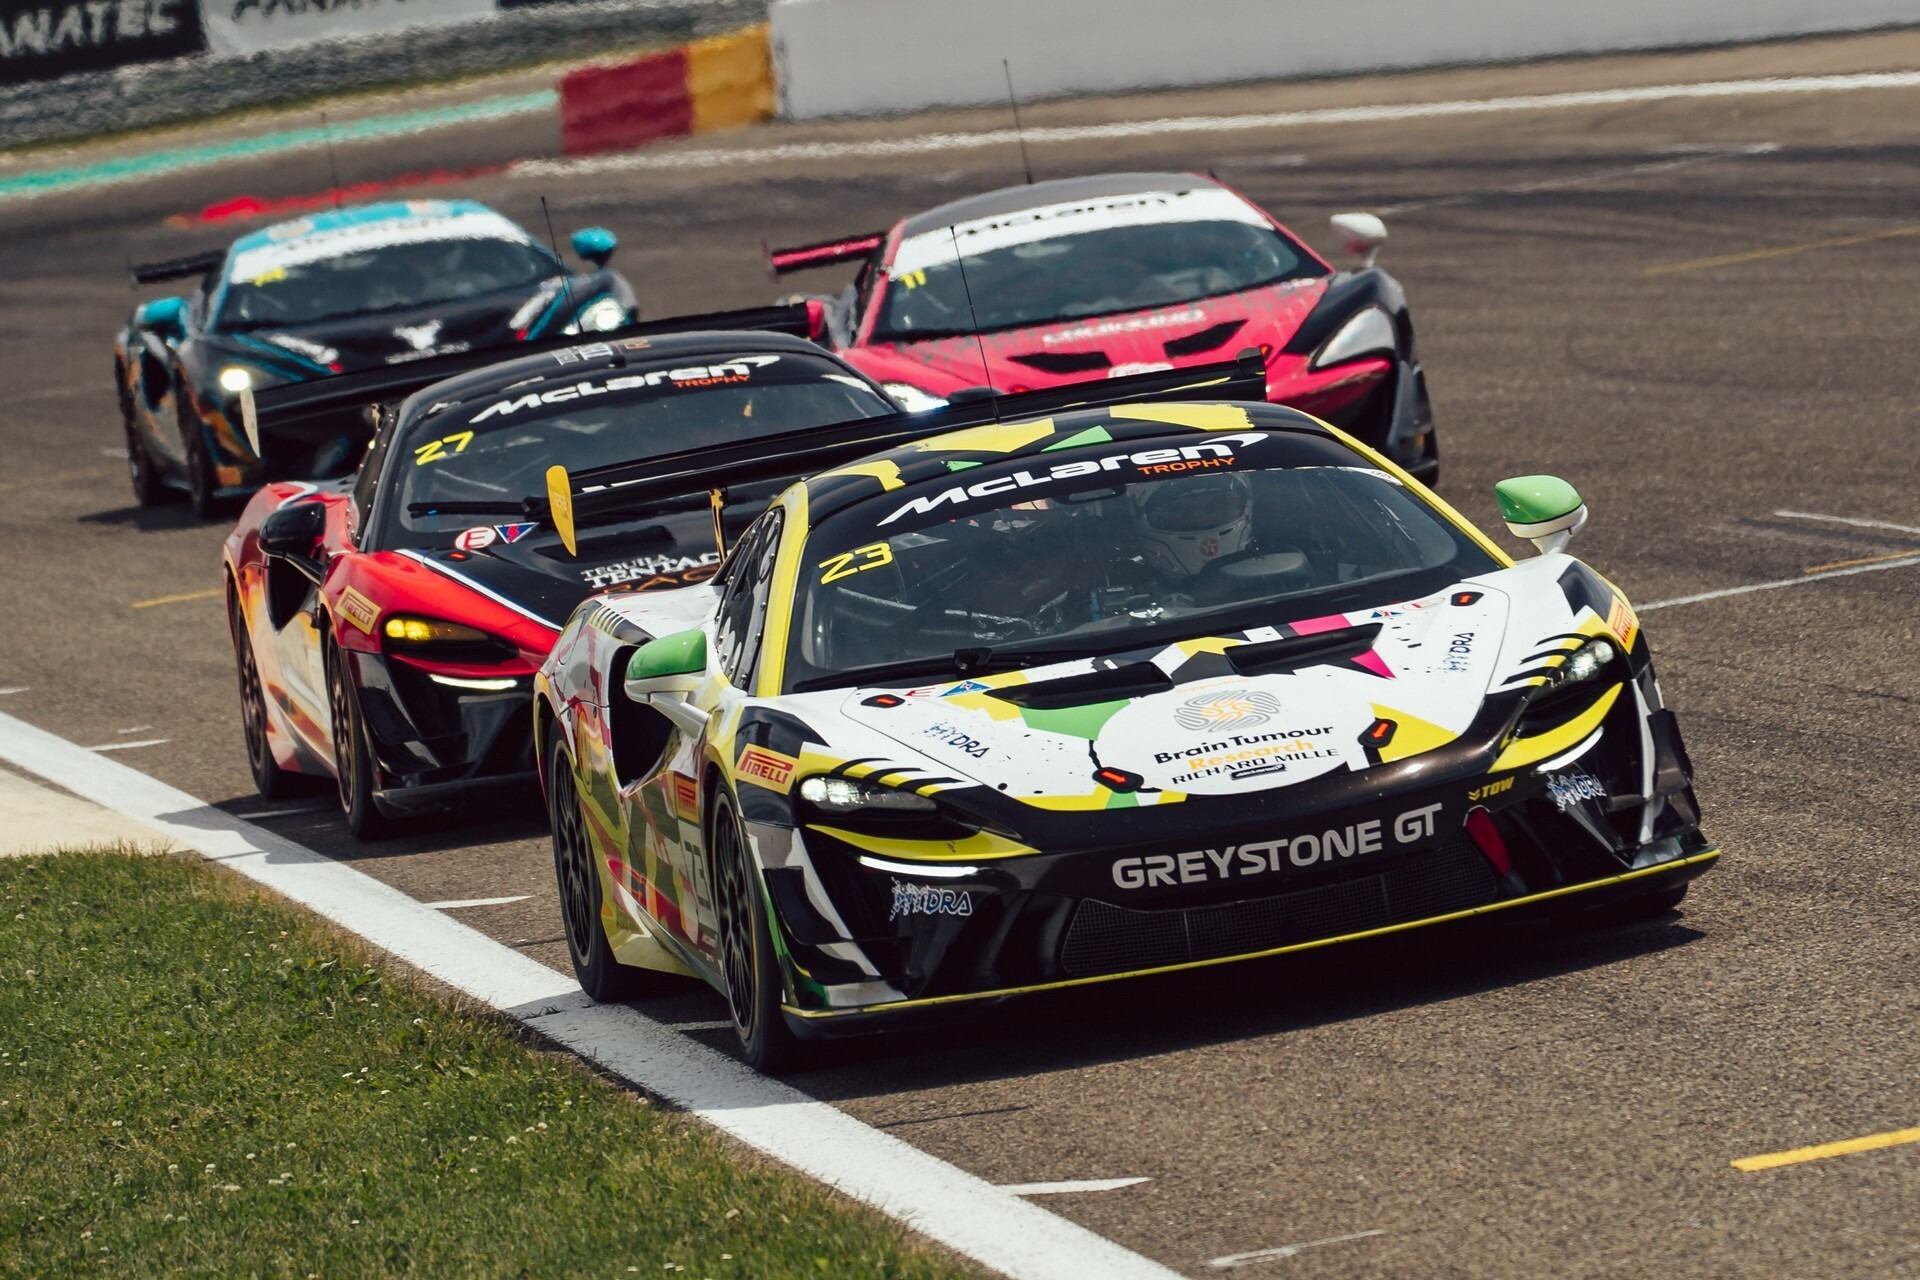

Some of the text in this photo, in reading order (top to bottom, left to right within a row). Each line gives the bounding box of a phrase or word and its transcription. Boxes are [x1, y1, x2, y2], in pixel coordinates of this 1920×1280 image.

[469, 355, 781, 424] McLaren
[673, 374, 751, 389] TROPHY
[414, 430, 474, 466] 27
[1136, 456, 1236, 476] TROPHY
[876, 432, 1270, 527] McLaren
[583, 549, 726, 589] TENTAC
[818, 542, 893, 585] 23
[340, 591, 375, 626] PIRELLI
[1154, 726, 1334, 764] Brain Tumour
[1188, 739, 1314, 771] Research
[740, 750, 794, 785] PIRELLI
[1171, 748, 1339, 785] RICHARD MILLE
[1482, 776, 1515, 798] TOW
[1112, 802, 1443, 889] GREYSTONE GT
[889, 877, 973, 921] HYDRA
